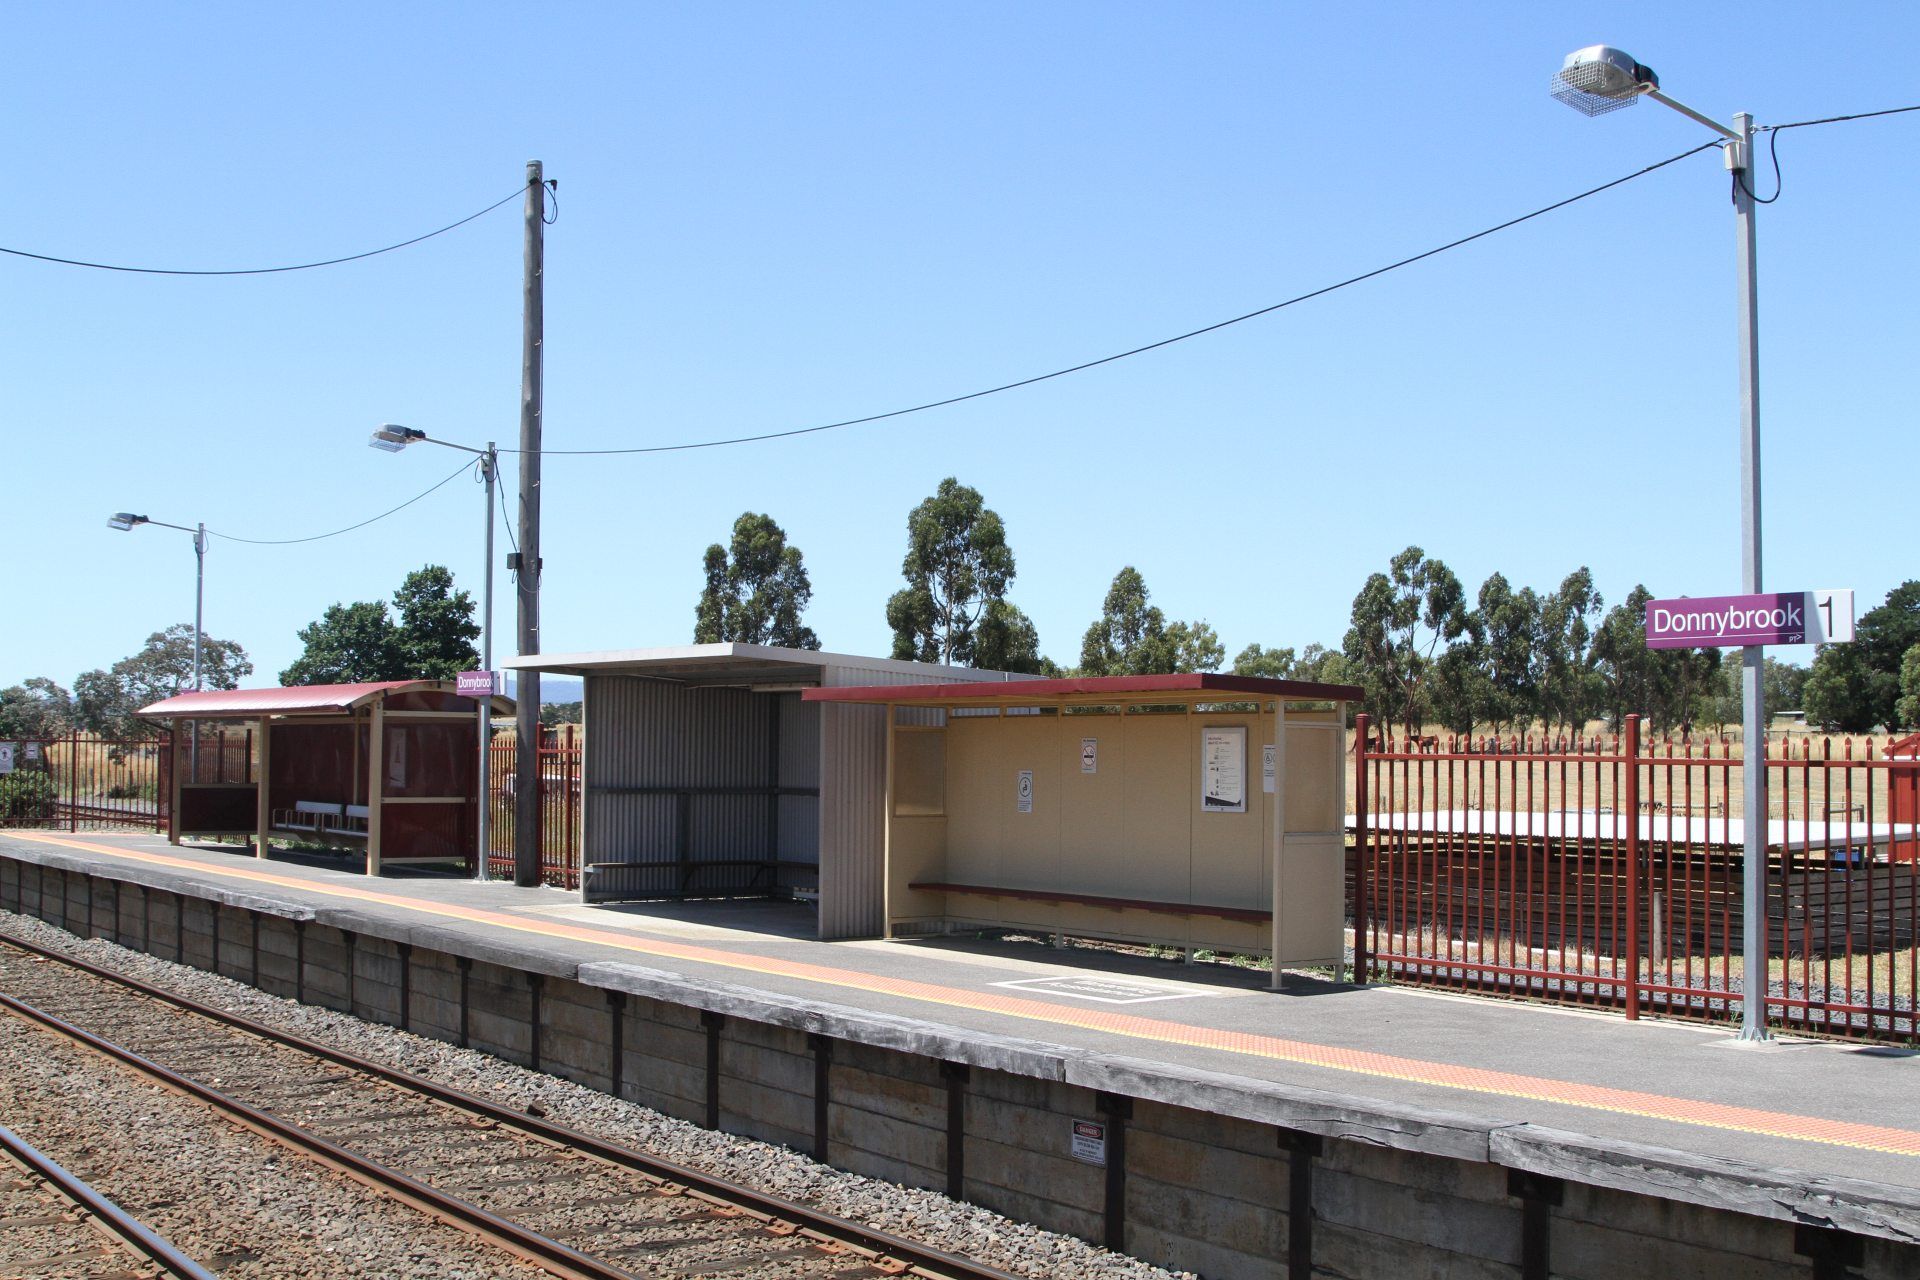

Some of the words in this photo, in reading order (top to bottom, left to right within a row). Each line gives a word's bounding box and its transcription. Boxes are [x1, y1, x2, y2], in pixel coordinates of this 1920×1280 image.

[1654, 602, 1802, 636] Donnybrook
[1818, 595, 1832, 637] 1
[458, 675, 493, 690] Donnybrook
